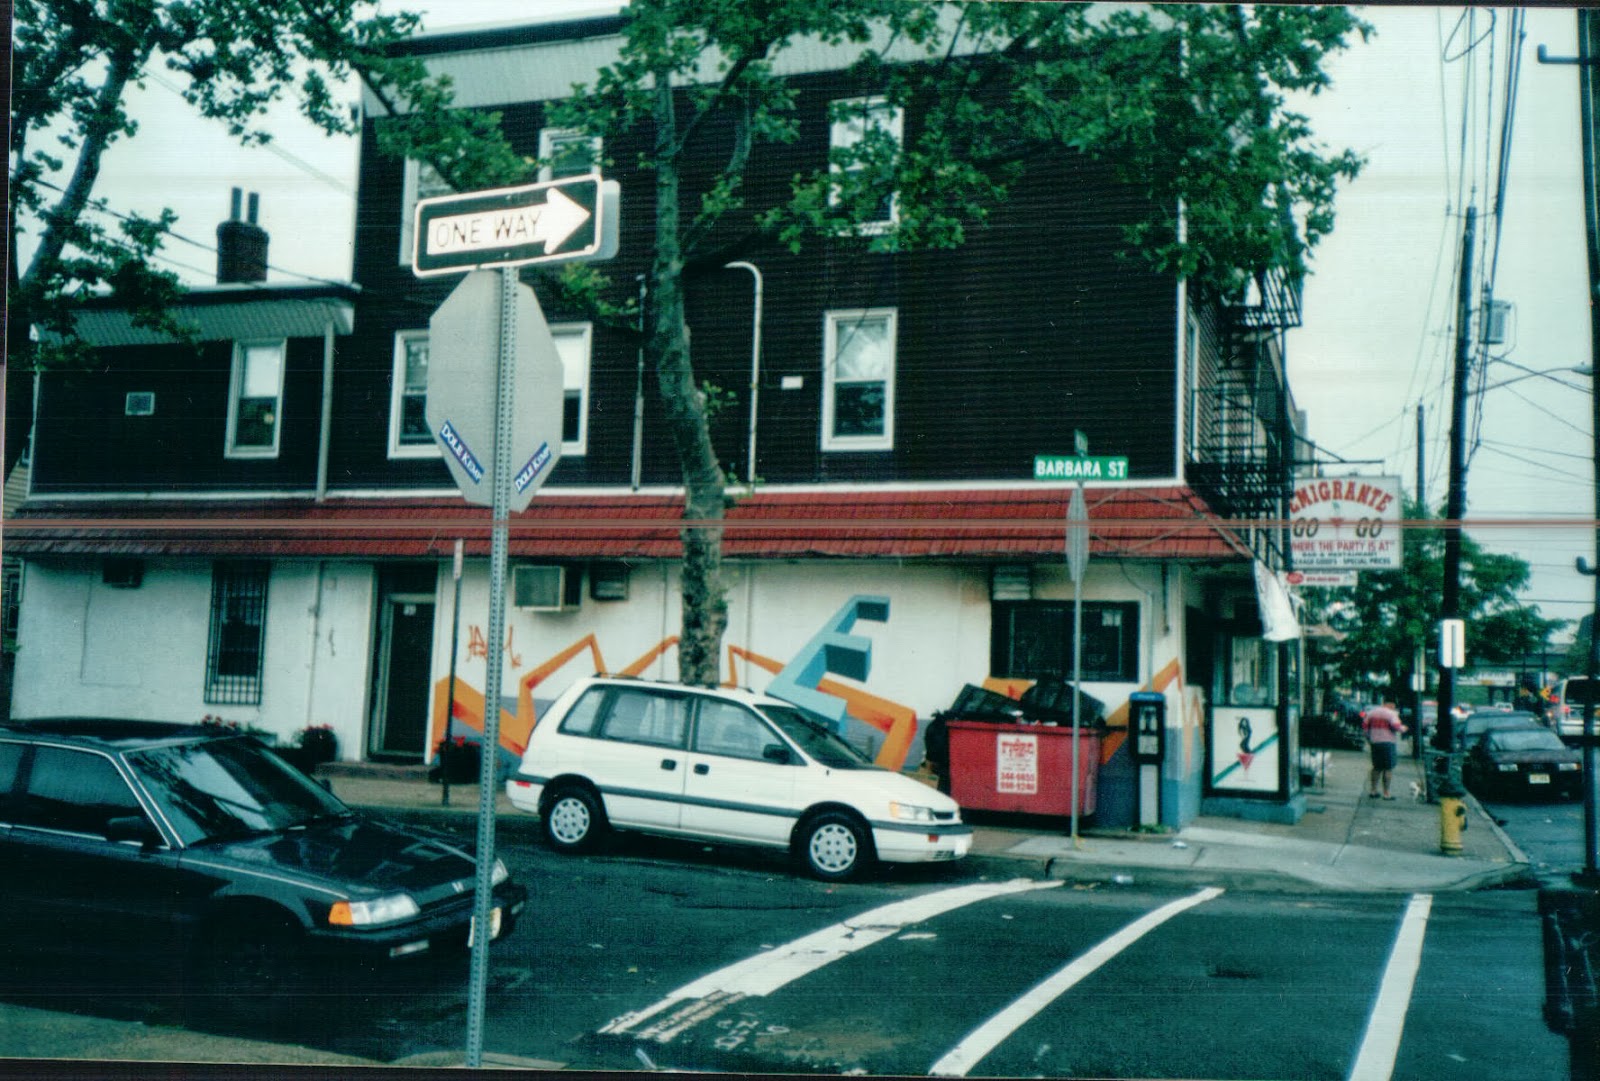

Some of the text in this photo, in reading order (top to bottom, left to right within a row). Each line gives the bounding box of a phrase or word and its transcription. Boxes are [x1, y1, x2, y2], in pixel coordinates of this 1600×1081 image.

[436, 210, 542, 248] ONE WAY
[441, 423, 464, 457] DOLE
[1035, 460, 1126, 478] BARBARA ST
[1293, 517, 1384, 538] GO GO
[1319, 541, 1333, 552] THE
[1337, 541, 1365, 552] PARTY
